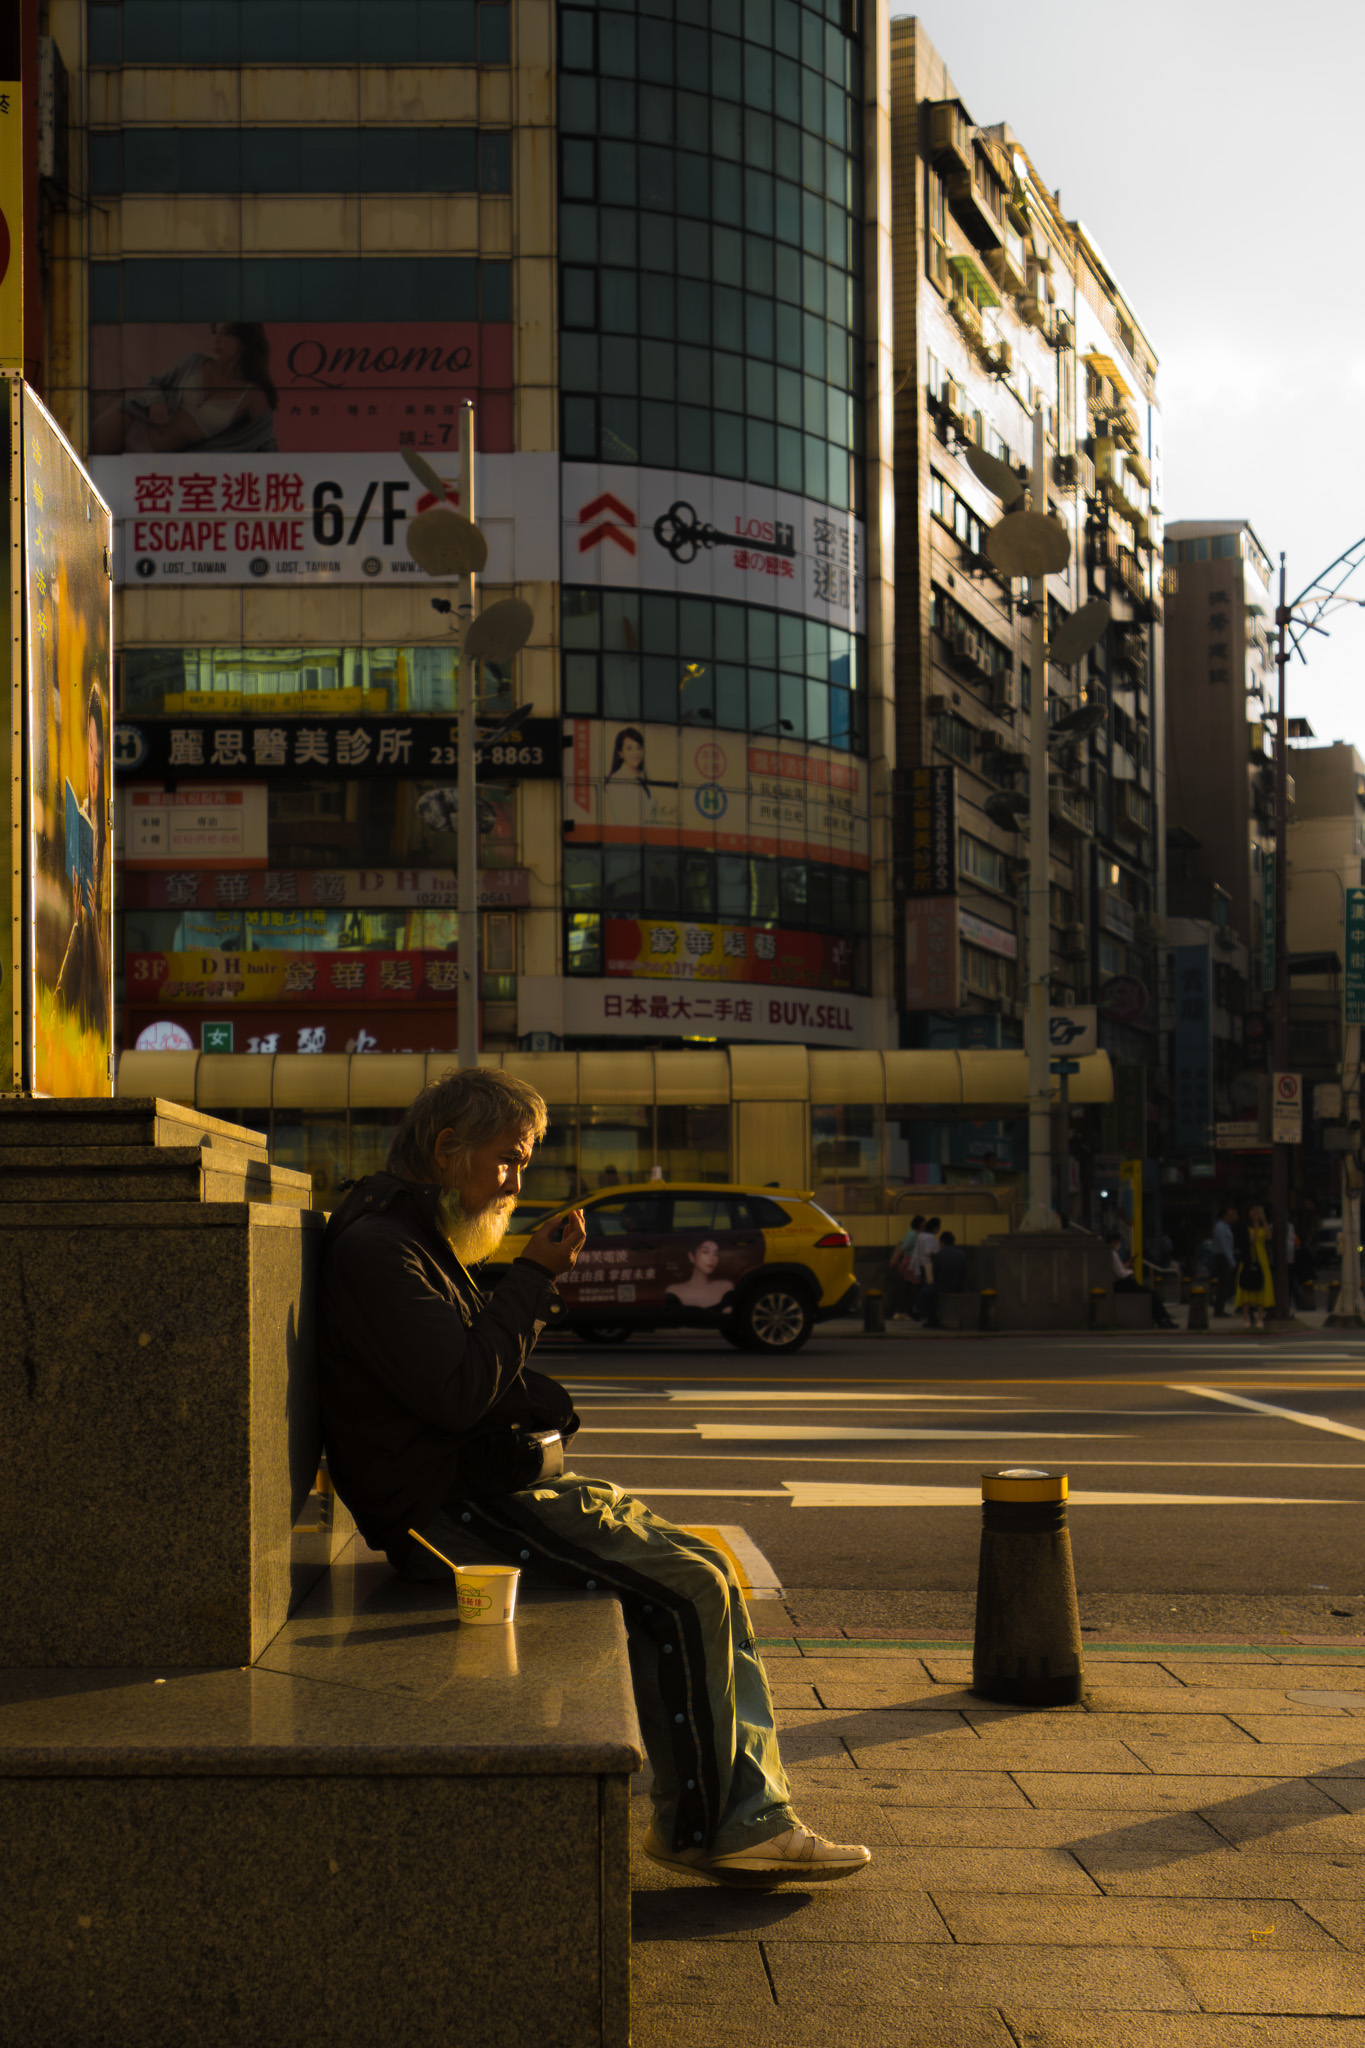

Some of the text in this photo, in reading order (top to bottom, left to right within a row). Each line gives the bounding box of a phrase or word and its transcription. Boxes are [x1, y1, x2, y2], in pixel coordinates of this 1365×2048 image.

[287, 339, 473, 388] Qmomo
[134, 473, 304, 514] 密室逃脫
[312, 481, 410, 546] 6/F
[134, 521, 304, 551] ESCAPE GAME
[162, 560, 227, 574] LOST_TAIWAN
[276, 560, 341, 574] LOST_TAIWAN
[168, 728, 414, 766] 麗思醫美診所
[430, 747, 543, 765] 238-8863
[497, 870, 524, 887] 3F
[416, 892, 512, 906] (02)23-0641
[133, 958, 167, 981] 3F
[247, 963, 277, 975] hair
[604, 995, 752, 1022] 日本最大二手店
